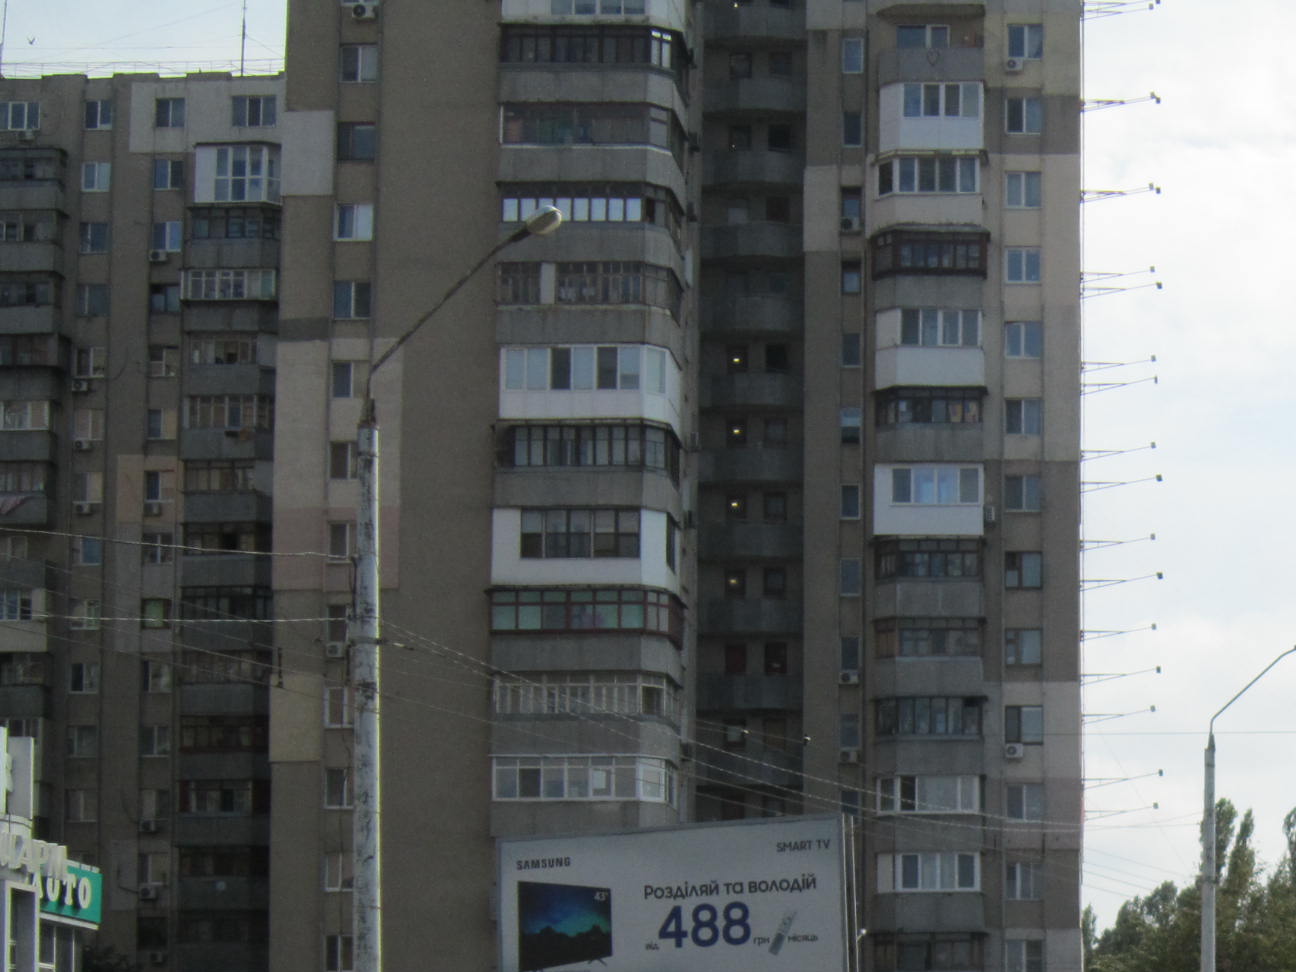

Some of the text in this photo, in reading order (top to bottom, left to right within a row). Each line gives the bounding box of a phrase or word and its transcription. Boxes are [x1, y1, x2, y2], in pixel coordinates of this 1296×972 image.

[776, 838, 831, 853] SMART TV
[516, 857, 572, 871] SAMSUNG
[32, 871, 92, 909] AUTO
[644, 873, 817, 900] Розділяй та володій
[658, 901, 751, 948] 488
[753, 936, 770, 946] грн
